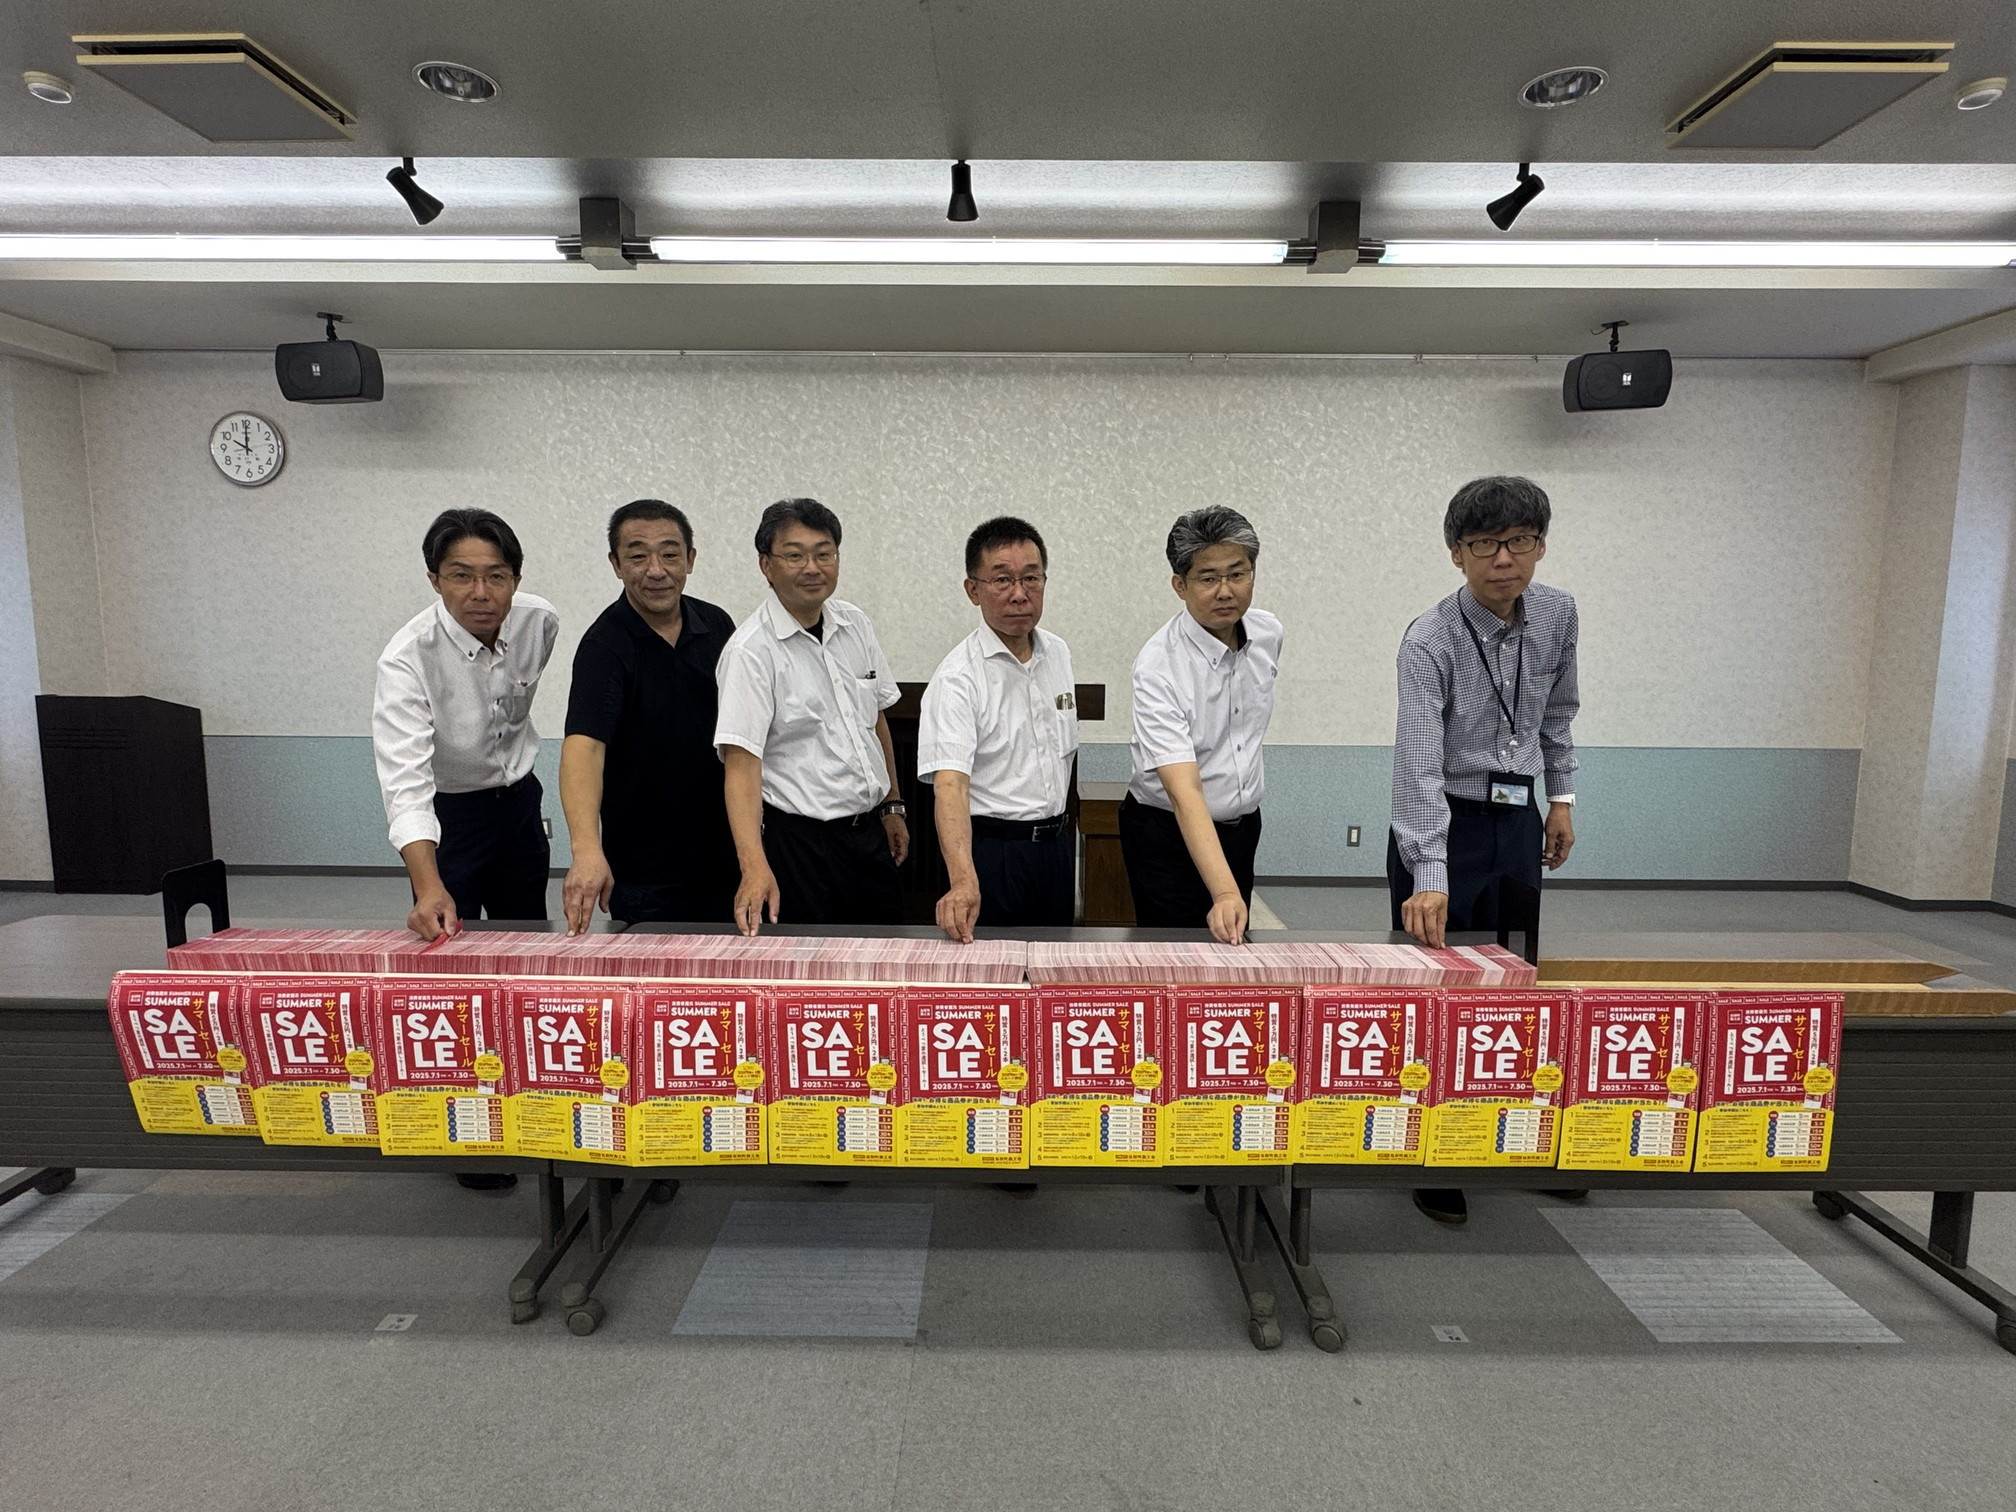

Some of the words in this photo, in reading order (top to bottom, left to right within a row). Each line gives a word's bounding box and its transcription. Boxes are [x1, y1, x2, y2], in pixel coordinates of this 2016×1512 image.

[222, 431, 231, 440] 10
[231, 423, 238, 432] 11
[241, 420, 250, 429] 12
[257, 423, 260, 432] 1
[264, 431, 271, 440] 2
[220, 444, 227, 453] 9
[225, 456, 231, 465] 8
[266, 457, 272, 465] 4
[268, 444, 274, 453] 3
[236, 465, 241, 474] 7
[246, 468, 253, 478] 6
[258, 465, 264, 474] 5
[145, 998, 189, 1006] SUMMER
[276, 999, 322, 1008] SUMMER
[408, 1001, 454, 1010] SUMMER
[539, 1004, 584, 1013] SUMMER
[671, 1007, 717, 1016] SUMMER
[804, 1010, 850, 1018] SUMMER
[935, 1011, 981, 1019] SUMMER
[1069, 1008, 1115, 1017] SUMMER
[1204, 1009, 1250, 1017] SUMMER
[1341, 1010, 1387, 1018] SUMMER
[144, 1009, 198, 1034] SA
[192, 998, 215, 1059] サマーセール
[276, 1010, 328, 1037] SA
[407, 1013, 458, 1040] SA
[538, 1016, 586, 1044] SA
[1475, 1013, 1521, 1022] SUMMER
[1610, 1013, 1656, 1021] SUMMER
[1745, 1015, 1792, 1024] SUMMER
[325, 999, 344, 1063] サマーセール
[457, 1002, 473, 1068] サマーセール
[587, 1006, 599, 1073] サマーセール
[668, 1019, 720, 1047] SA
[720, 1008, 733, 1076] サマーセール
[802, 1022, 853, 1048] SA
[852, 1011, 866, 1077] サマーセール
[933, 1022, 984, 1050] SA
[1067, 1020, 1118, 1046] SA
[1118, 1009, 1131, 1075] サマーセール
[1202, 1020, 1253, 1047] SA
[1254, 1009, 1265, 1075] サマーセール
[1337, 1021, 1388, 1048] SA
[1388, 1011, 1402, 1076] サマーセール
[1471, 1025, 1522, 1051] SA
[1605, 1024, 1656, 1051] SA
[1741, 1026, 1792, 1054] SA
[154, 1035, 201, 1059] LE
[284, 1038, 329, 1063] LE
[413, 1042, 457, 1067] LE
[544, 1044, 584, 1072] LE
[984, 1012, 997, 1078] サマーセール
[1521, 1014, 1536, 1079] サマーセール
[1655, 1014, 1670, 1080] サマーセール
[1792, 1015, 1806, 1081] サマーセール
[674, 1049, 717, 1076] LE
[807, 1050, 850, 1076] LE
[938, 1052, 981, 1078] LE
[1072, 1048, 1115, 1074] LE
[1206, 1049, 1249, 1075] LE
[1340, 1050, 1384, 1076] LE
[1474, 1053, 1517, 1079] LE
[1608, 1054, 1651, 1079] LE
[1744, 1055, 1788, 1082] LE
